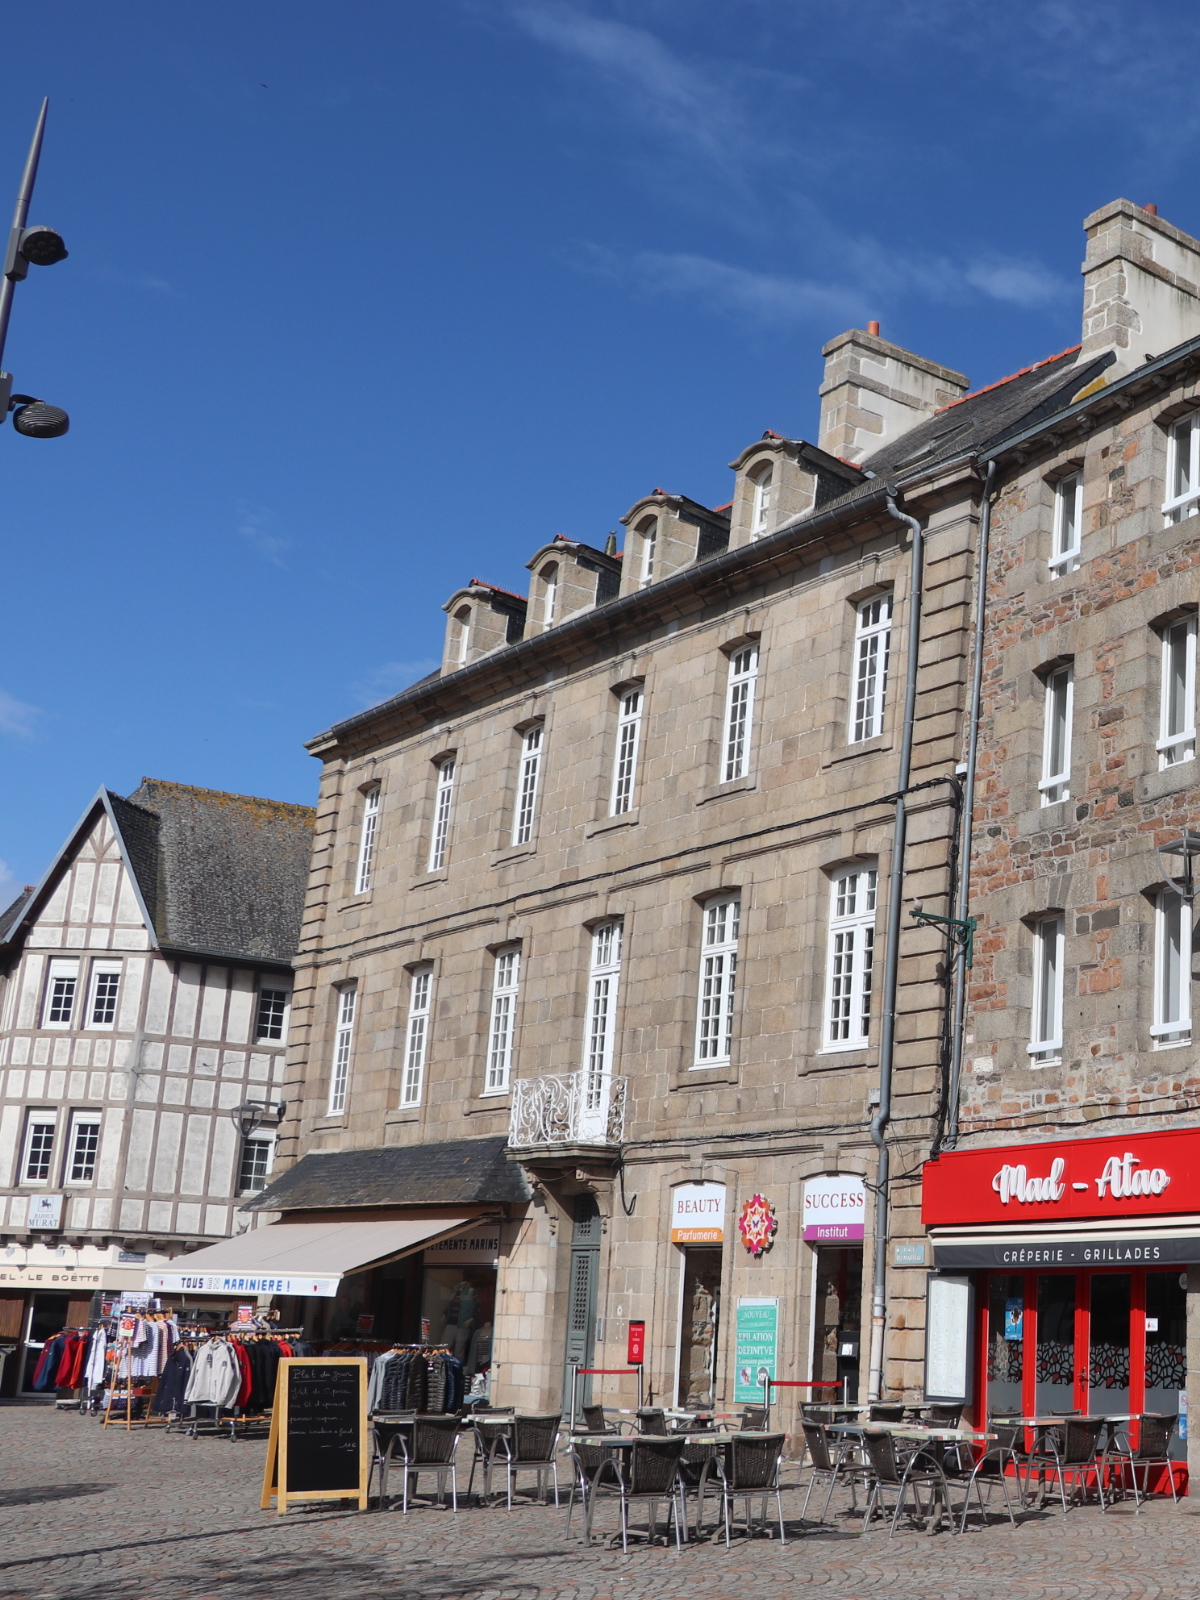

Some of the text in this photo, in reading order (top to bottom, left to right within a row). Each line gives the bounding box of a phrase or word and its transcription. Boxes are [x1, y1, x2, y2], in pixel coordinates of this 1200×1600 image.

[992, 1157, 1066, 1204] Mad
[677, 1199, 721, 1214] BEAUTY
[805, 1192, 863, 1209] SUCCESS
[28, 1218, 58, 1227] MURAT
[677, 1229, 718, 1241] Parfumerie
[817, 1226, 848, 1238] Institut
[469, 1239, 498, 1251] MARINS
[1003, 1249, 1063, 1262] CRÊPERIE
[1084, 1247, 1160, 1261] GRILLADES
[181, 1277, 204, 1289] TOUS
[206, 1277, 220, 1290] EN
[223, 1278, 283, 1292] MARINIERE
[738, 1332, 773, 1342] EPILATION
[292, 1368, 316, 1379] Plat
